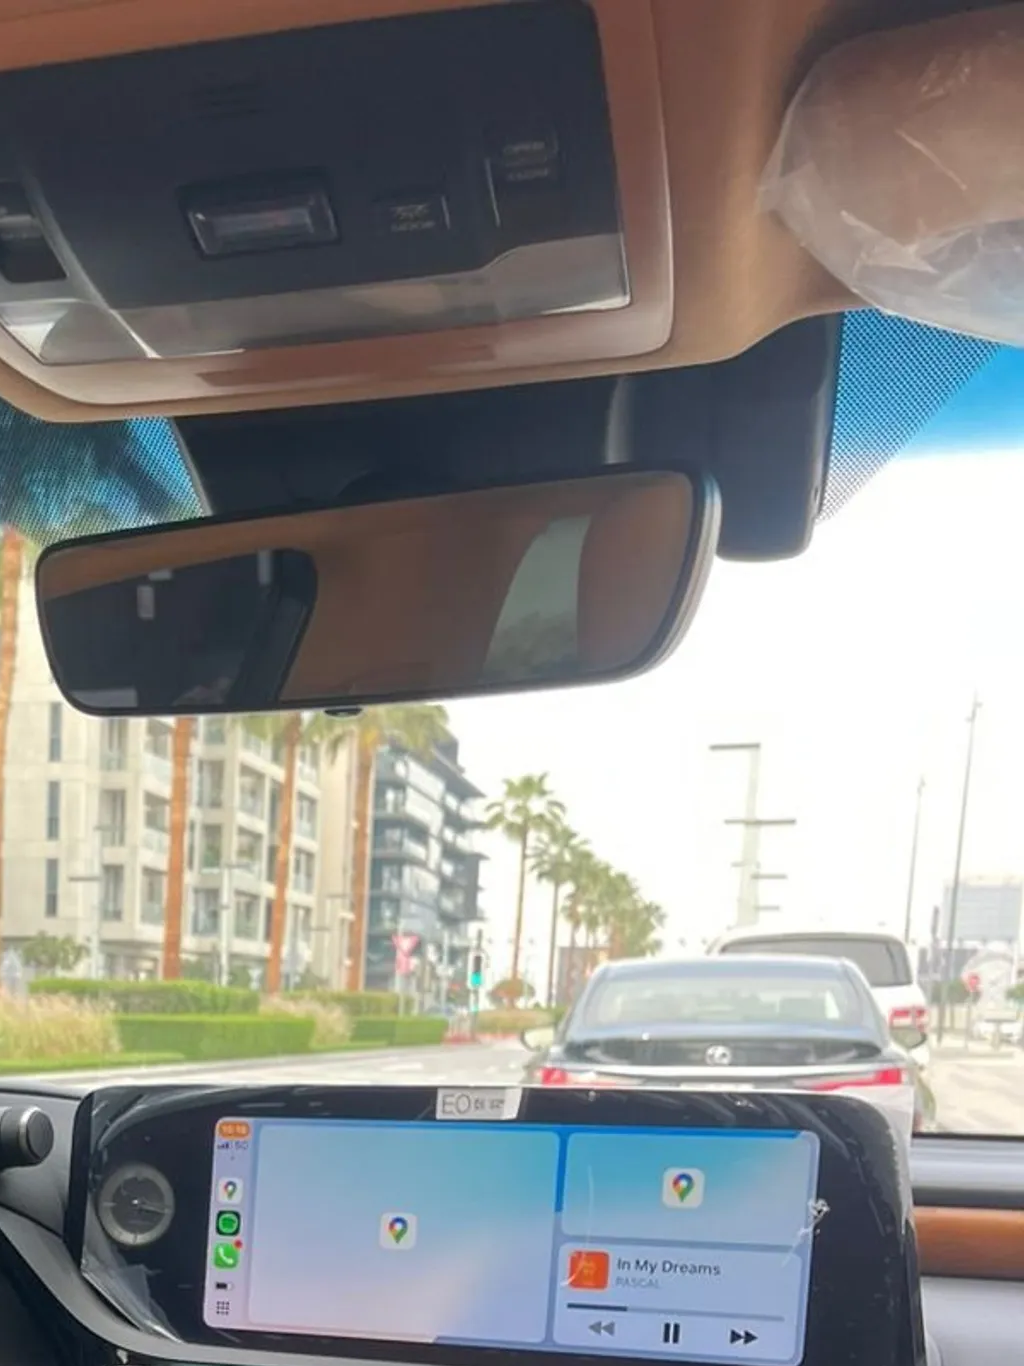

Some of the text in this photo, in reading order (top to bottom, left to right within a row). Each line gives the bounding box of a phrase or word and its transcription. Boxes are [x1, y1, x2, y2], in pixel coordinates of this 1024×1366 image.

[617, 1258, 721, 1275] In My Dreams
